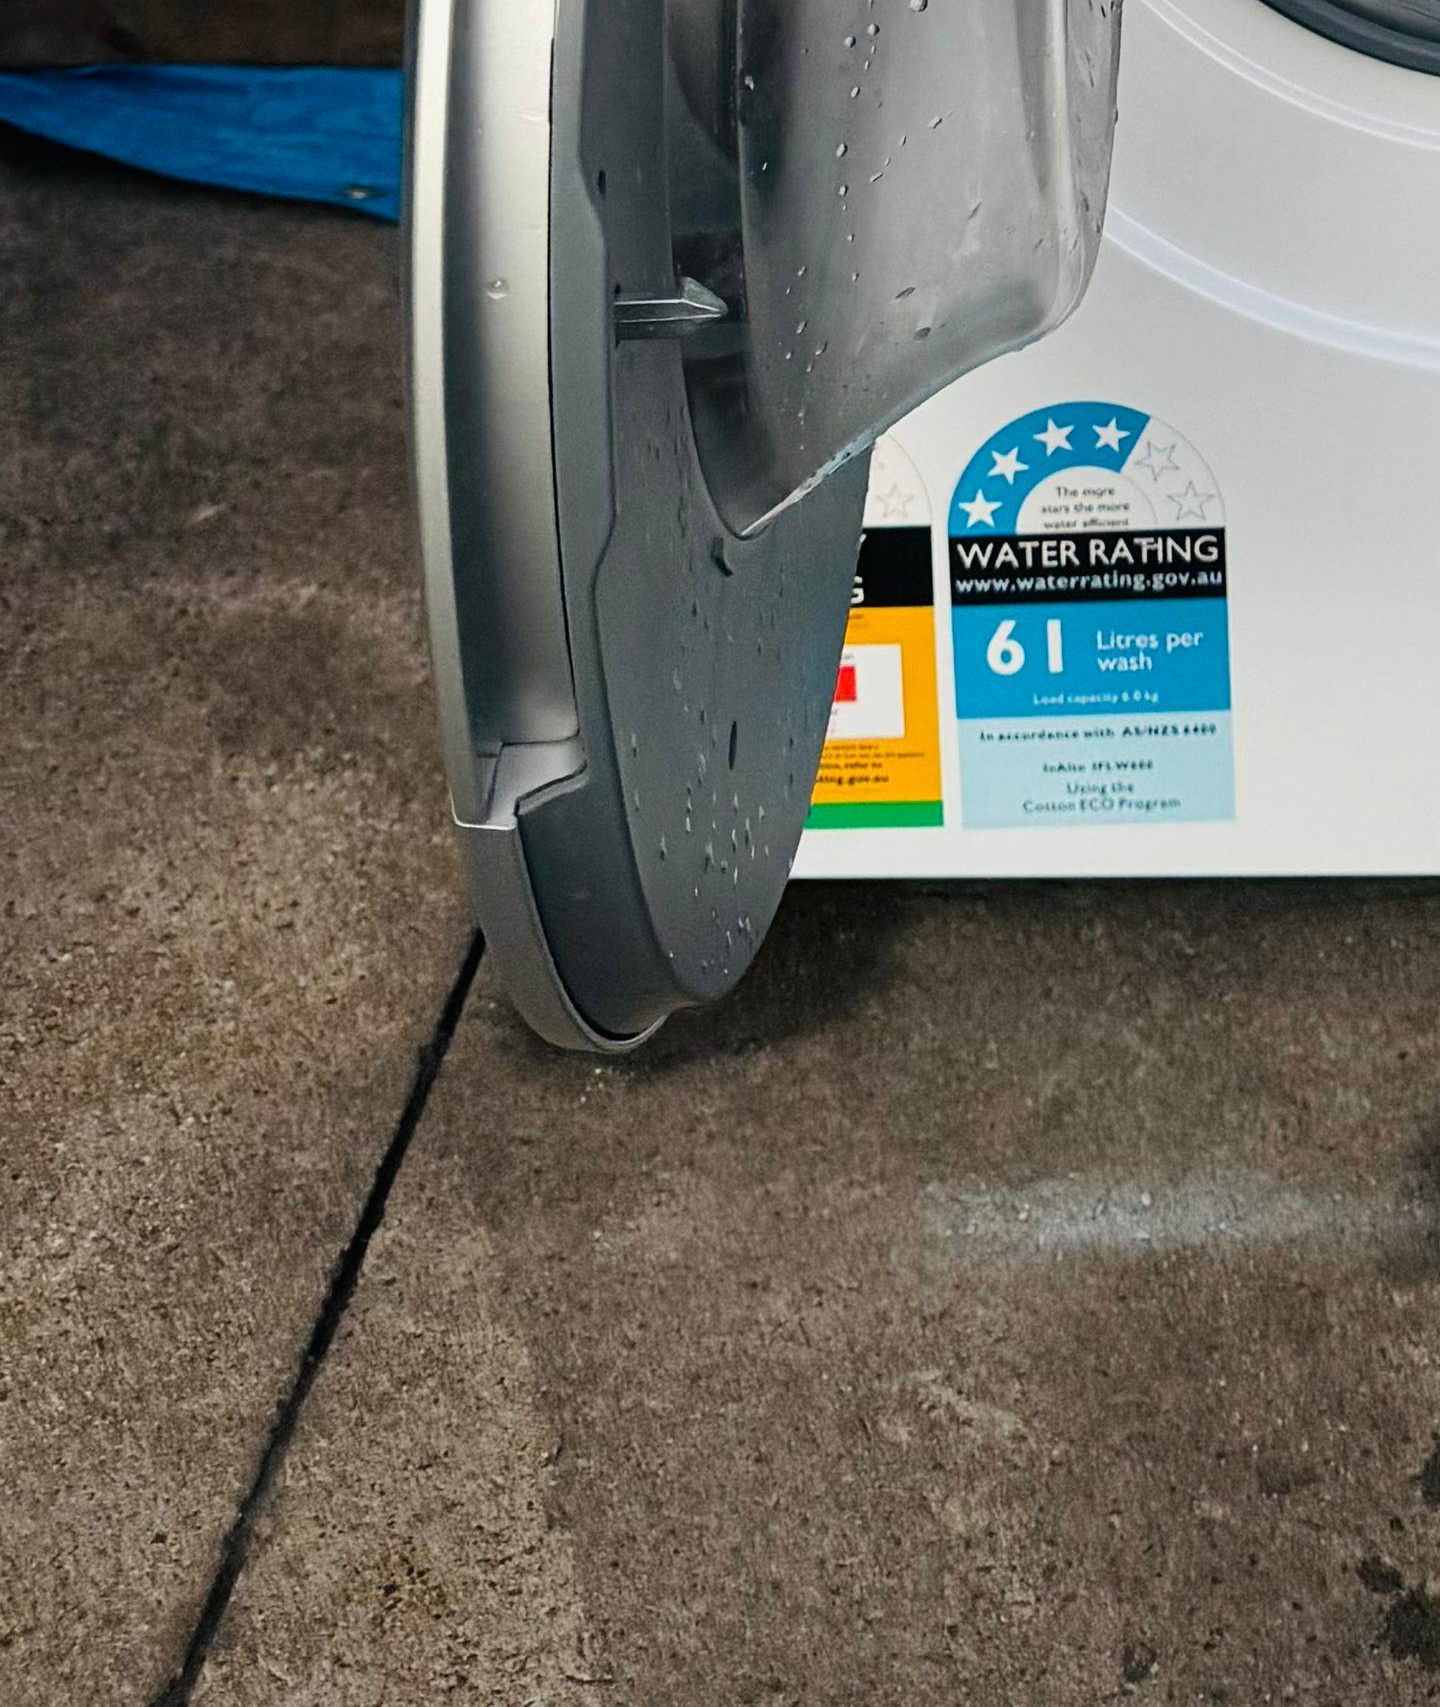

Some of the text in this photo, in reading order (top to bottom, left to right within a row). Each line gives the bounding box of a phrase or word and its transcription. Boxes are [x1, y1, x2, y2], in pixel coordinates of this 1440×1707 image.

[1056, 486, 1115, 498] The more
[1042, 502, 1130, 514] stars the more
[957, 534, 1219, 570] WATER RATING
[955, 569, 1223, 593] www.waterrating.gov.au
[1096, 630, 1159, 651] Litres
[1166, 630, 1204, 654] per
[1097, 651, 1153, 673] wash
[1033, 693, 1064, 706] Load
[1067, 691, 1118, 706] capacity
[979, 730, 994, 742] In
[998, 728, 1079, 741] accordance
[1083, 728, 1115, 739] with
[1066, 782, 1135, 796] Using the
[1022, 797, 1181, 813] Cotton ECO Program
